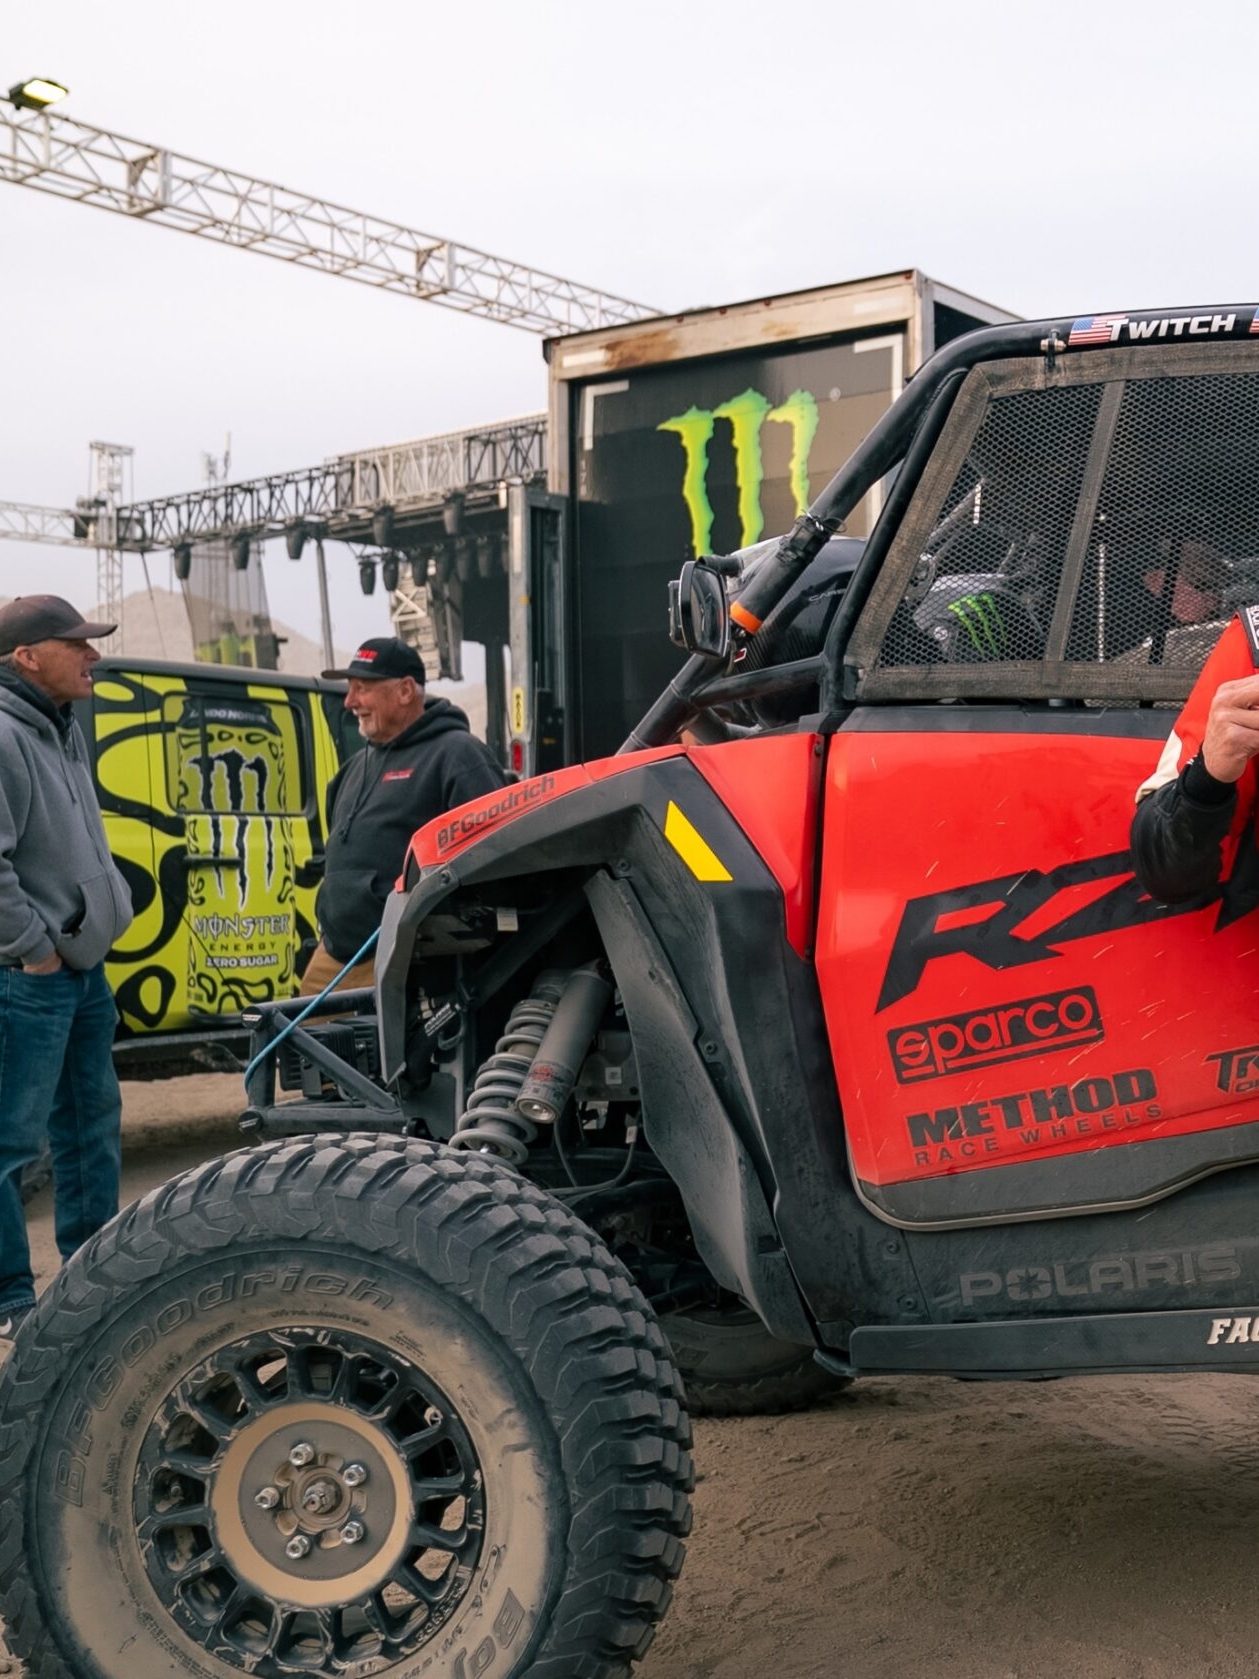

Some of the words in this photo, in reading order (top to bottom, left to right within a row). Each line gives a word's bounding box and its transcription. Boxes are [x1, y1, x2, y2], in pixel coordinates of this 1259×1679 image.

[437, 776, 555, 850] BFGoodrich
[209, 941, 277, 952] ENERGY
[239, 953, 279, 968] SUGAR
[894, 993, 1095, 1076] sparco
[906, 1068, 1159, 1148] METHOD
[914, 1137, 999, 1166] RACE
[1019, 1103, 1164, 1146] WHEELS
[959, 1247, 1242, 1307] POLARIS
